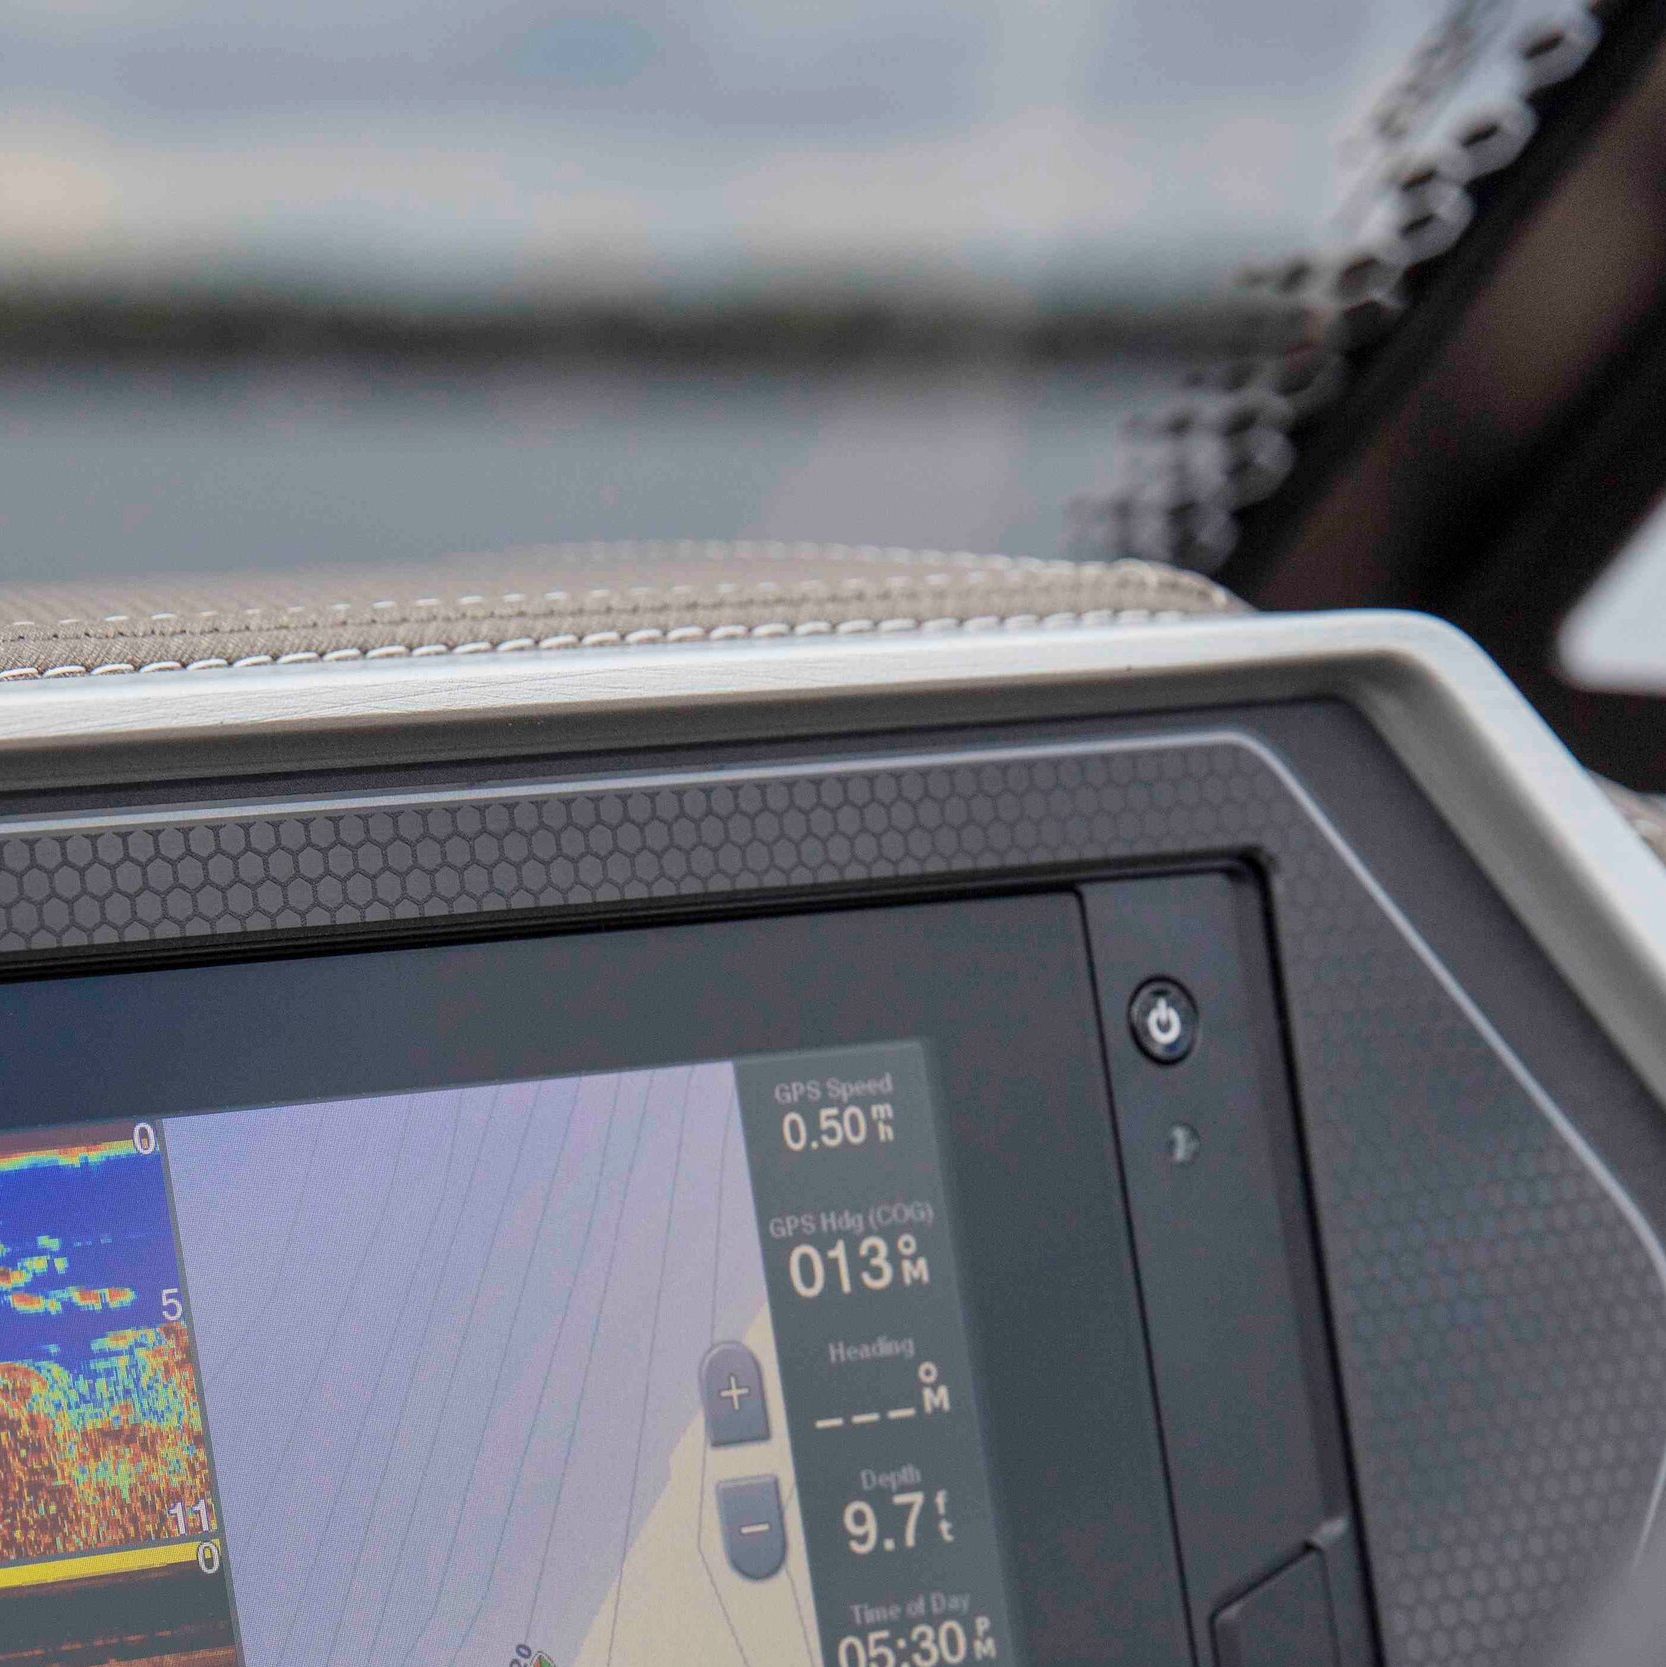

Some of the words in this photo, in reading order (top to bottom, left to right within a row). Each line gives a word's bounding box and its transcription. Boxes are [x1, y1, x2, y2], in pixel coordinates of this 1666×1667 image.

[774, 1079, 822, 1104] GPS
[826, 1071, 893, 1103] Speed
[131, 1121, 157, 1156] 0
[782, 1105, 867, 1151] 0.50
[769, 1212, 816, 1239] GPS
[820, 1208, 864, 1235] Hdg
[868, 1200, 934, 1231] (COG)
[788, 1236, 892, 1299] 013
[160, 1287, 184, 1323] 5
[828, 1334, 916, 1364] Heading
[859, 1463, 922, 1491] Depth
[167, 1498, 214, 1535] 11
[843, 1491, 924, 1554] 9.7
[196, 1541, 221, 1575] 0
[849, 1602, 901, 1626] Time
[905, 1594, 926, 1619] of
[930, 1592, 970, 1616] Day
